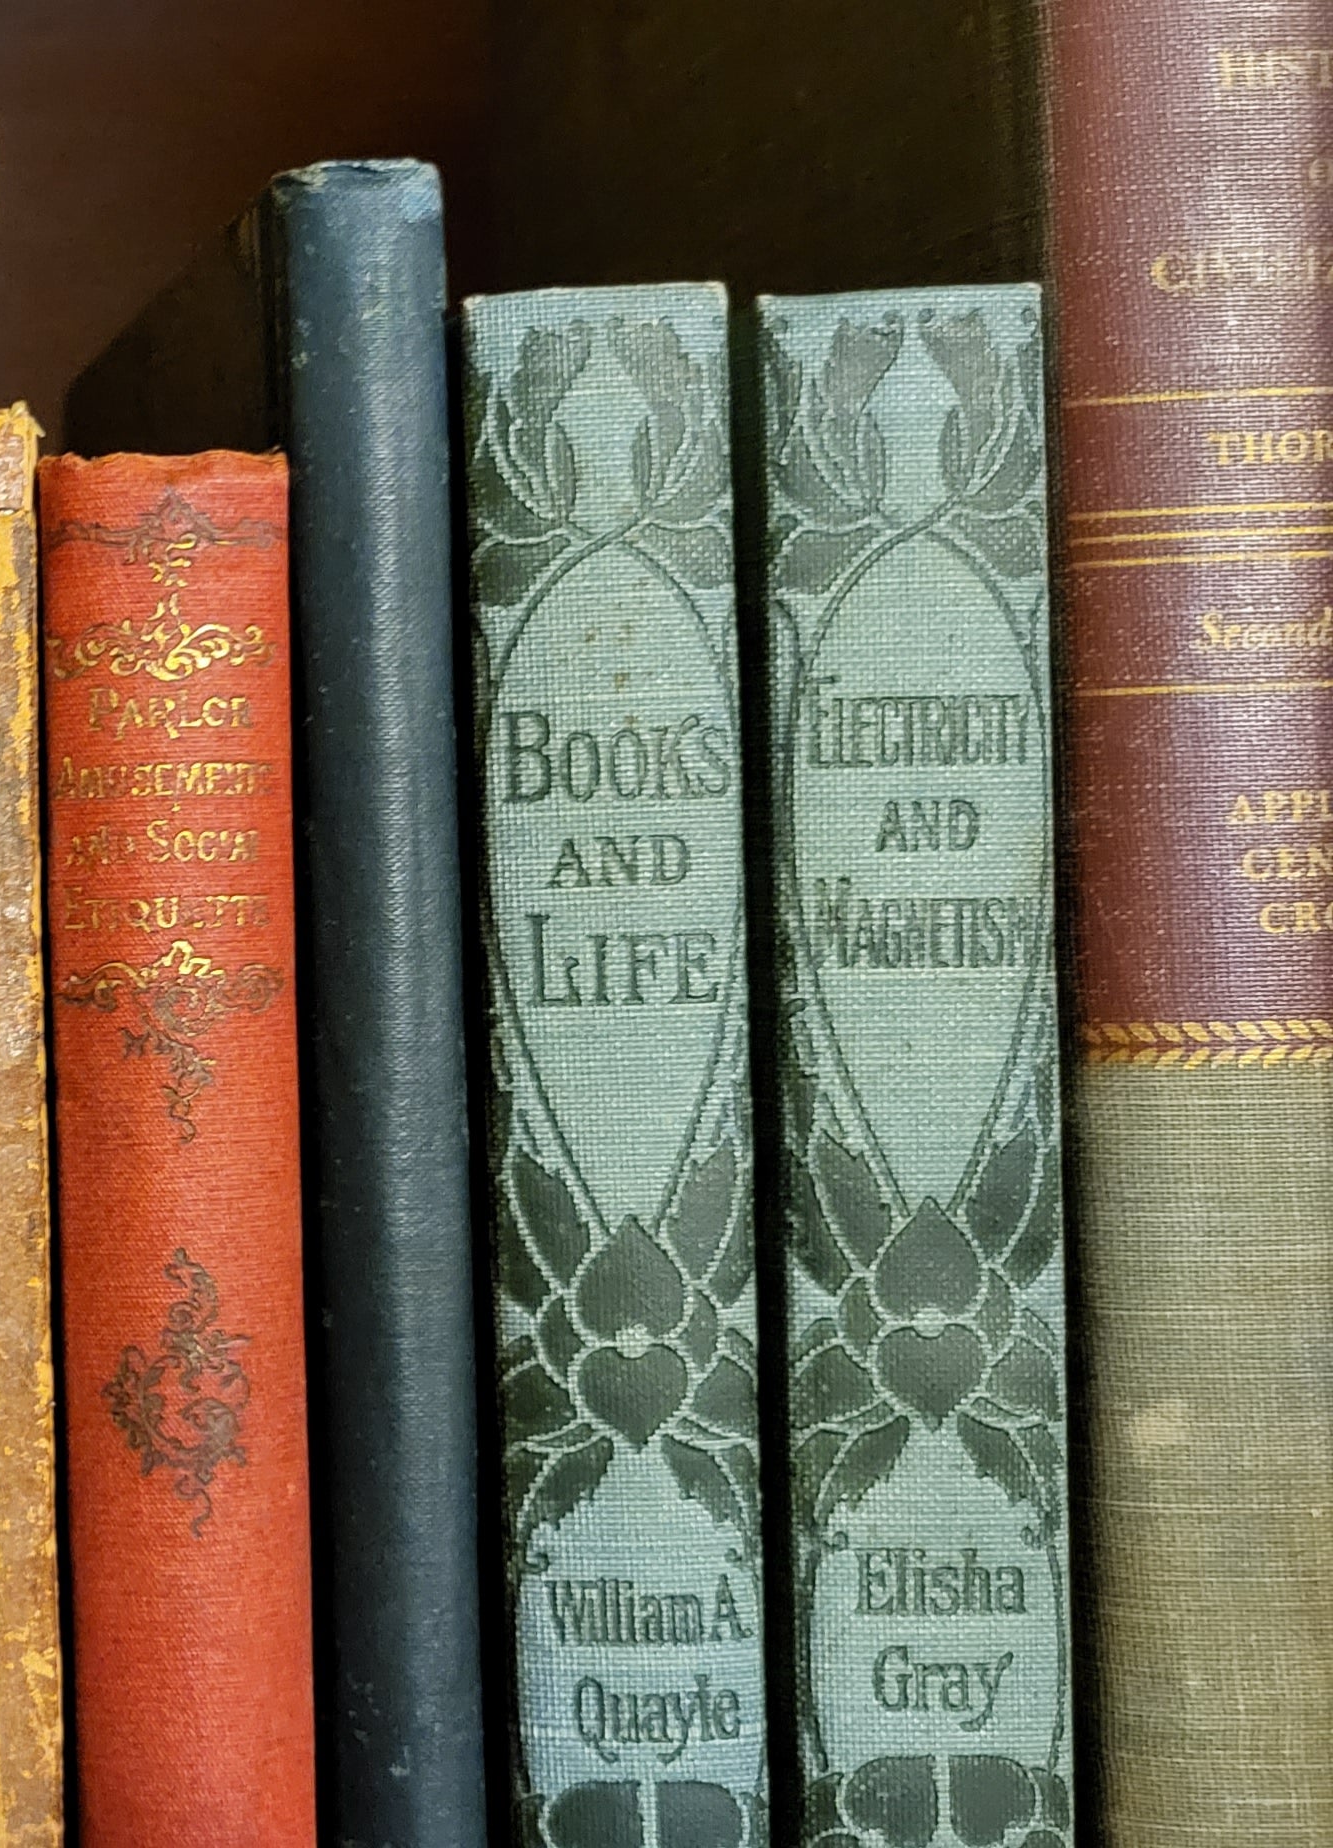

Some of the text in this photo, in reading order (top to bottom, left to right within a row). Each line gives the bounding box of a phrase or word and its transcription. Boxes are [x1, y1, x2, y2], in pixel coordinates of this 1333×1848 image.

[89, 687, 253, 741] PARLOR
[499, 709, 731, 804] BOOKS
[806, 674, 1031, 770] ELECTRICITY
[546, 834, 690, 888] AND
[874, 799, 981, 853] AND
[524, 912, 719, 1008] LIFE
[811, 876, 1035, 968] MAGNETISM
[544, 1576, 704, 1647] William
[854, 1546, 1027, 1617] Elisha
[573, 1674, 742, 1765] Quayle
[873, 1643, 1015, 1733] Gray
